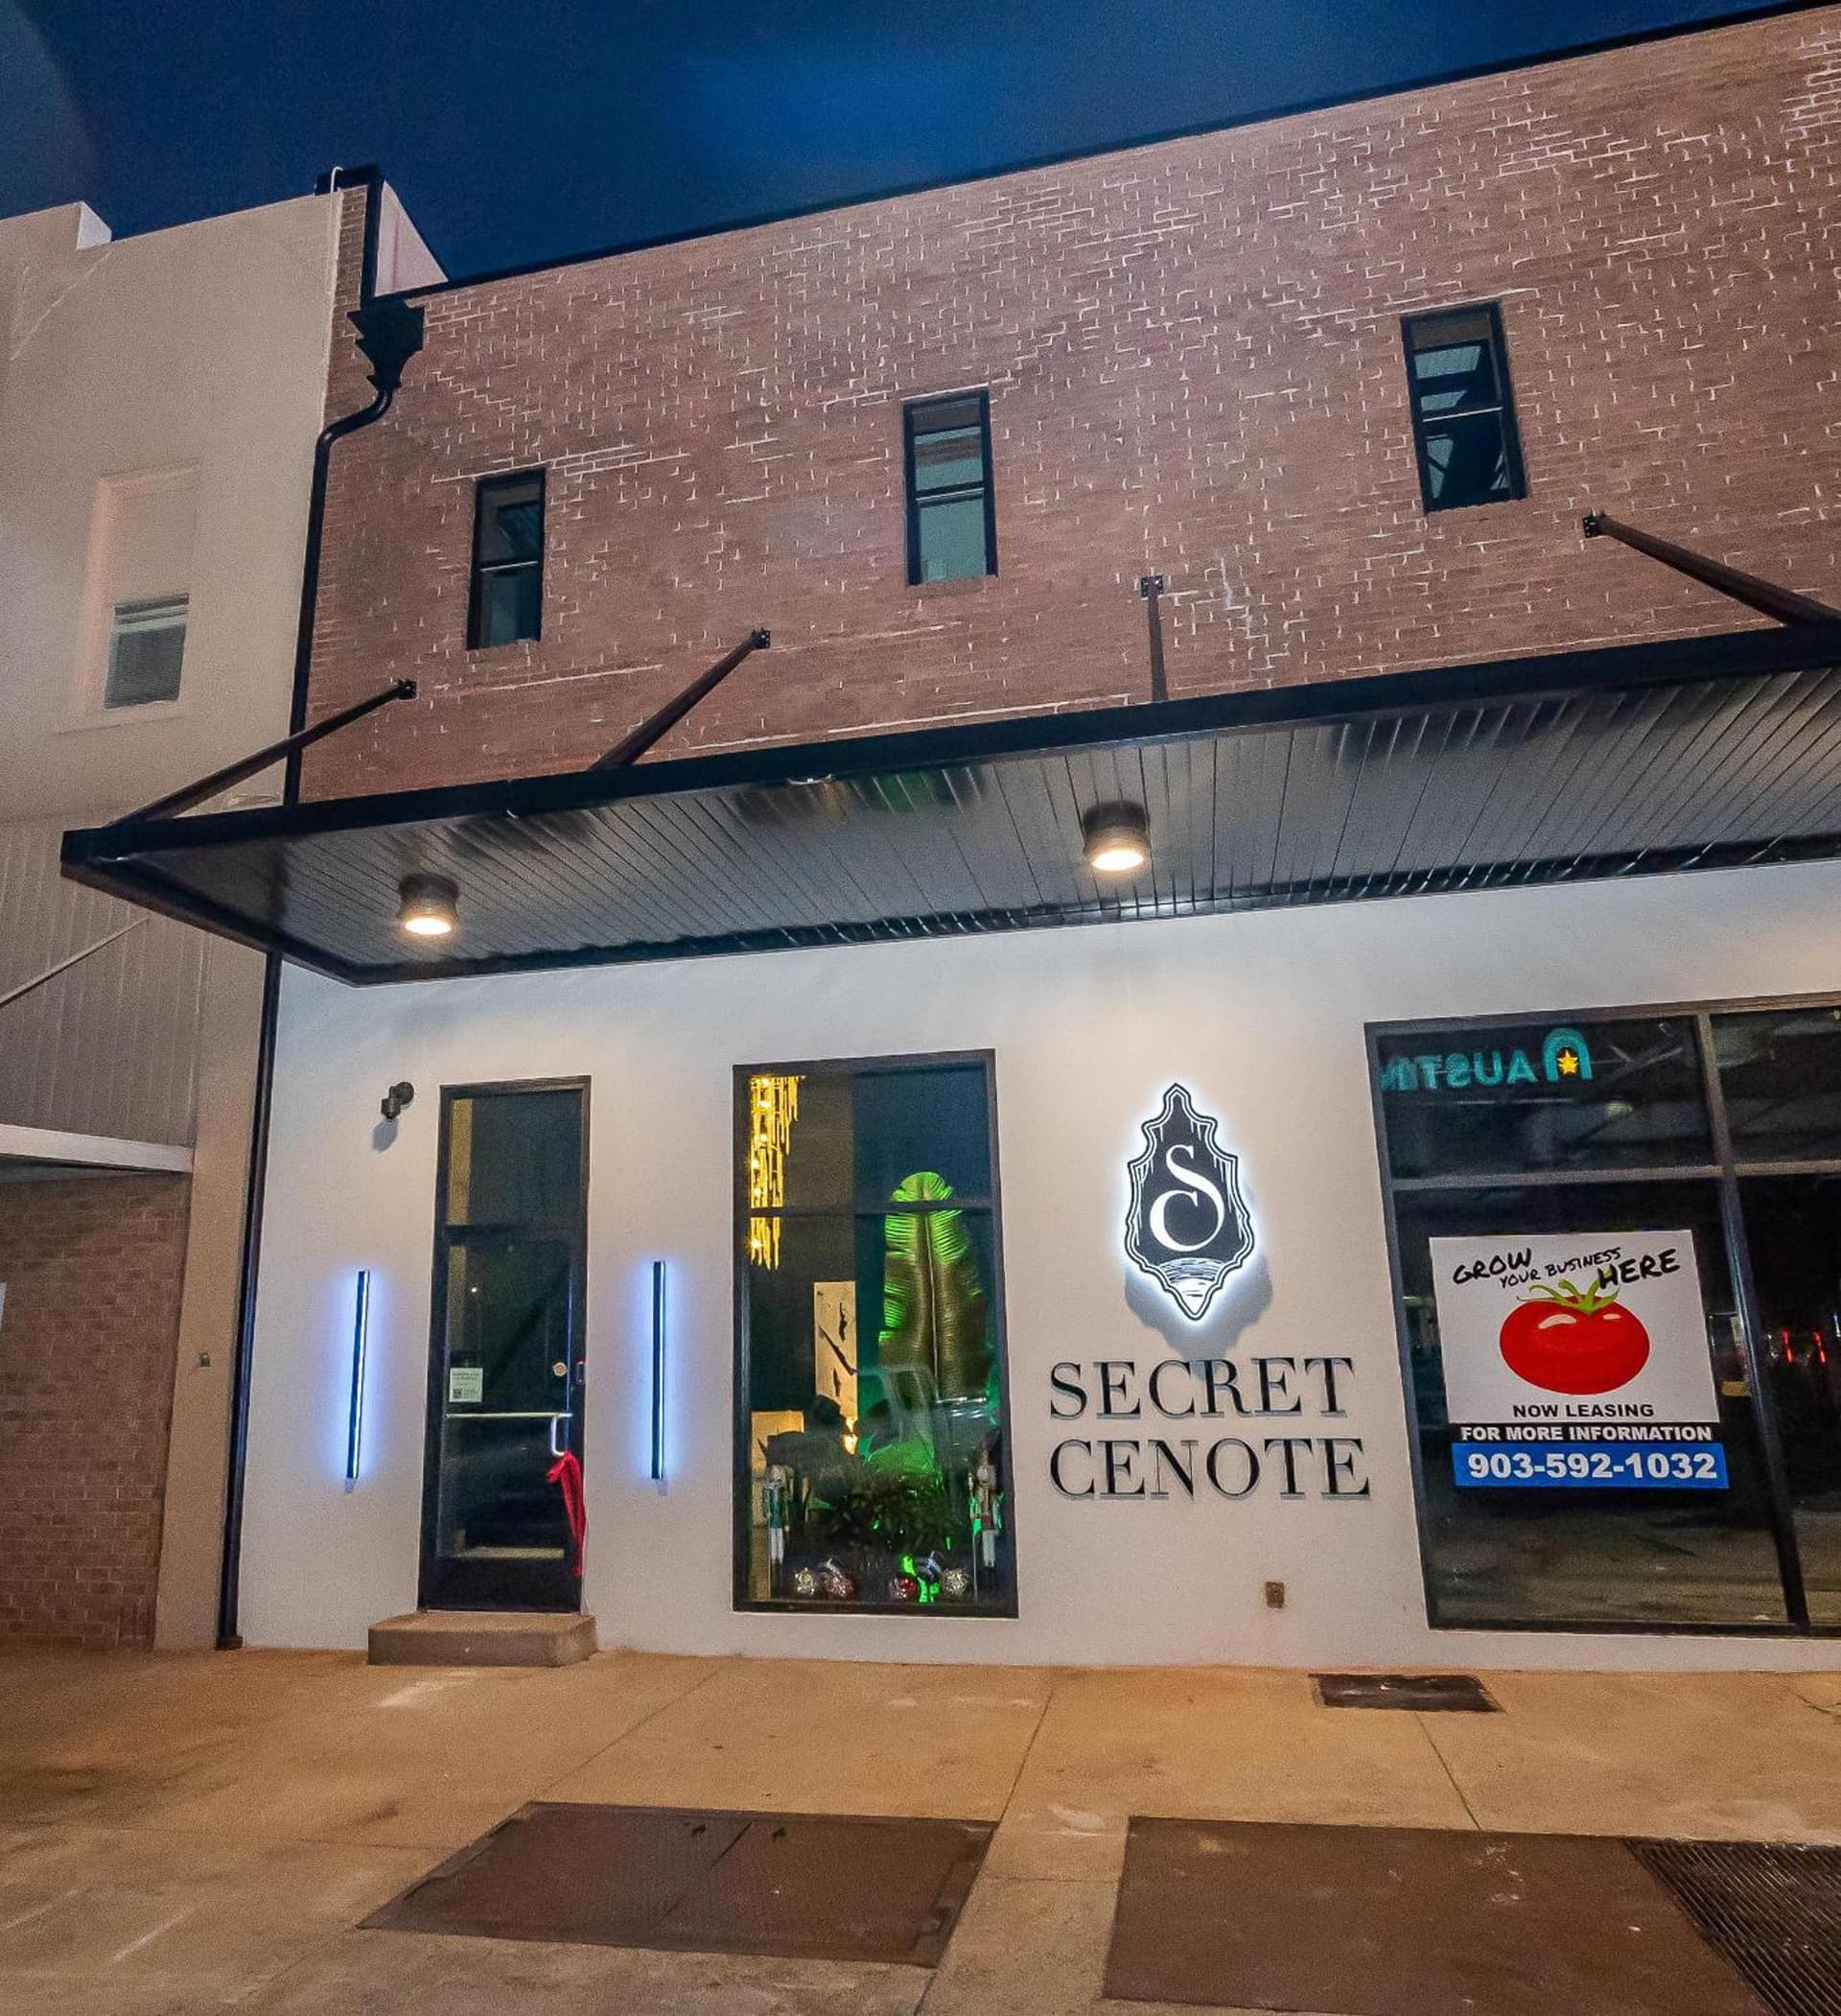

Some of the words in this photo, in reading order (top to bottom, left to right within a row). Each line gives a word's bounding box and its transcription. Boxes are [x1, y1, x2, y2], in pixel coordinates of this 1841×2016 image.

[1453, 1248, 1532, 1284] GROW
[1500, 1269, 1542, 1288] YOUR
[1545, 1247, 1621, 1278] BUSINESS
[1596, 1249, 1681, 1289] HERE
[1050, 1357, 1353, 1419] SECRET
[1513, 1404, 1558, 1418] NOW
[1565, 1403, 1655, 1418] LEASING
[1461, 1426, 1501, 1442] FOR
[1505, 1426, 1564, 1442] MORE
[1569, 1426, 1713, 1442] INFORMATION
[1050, 1438, 1370, 1501] CENOTE
[1468, 1452, 1718, 1479] 903-592-1032
